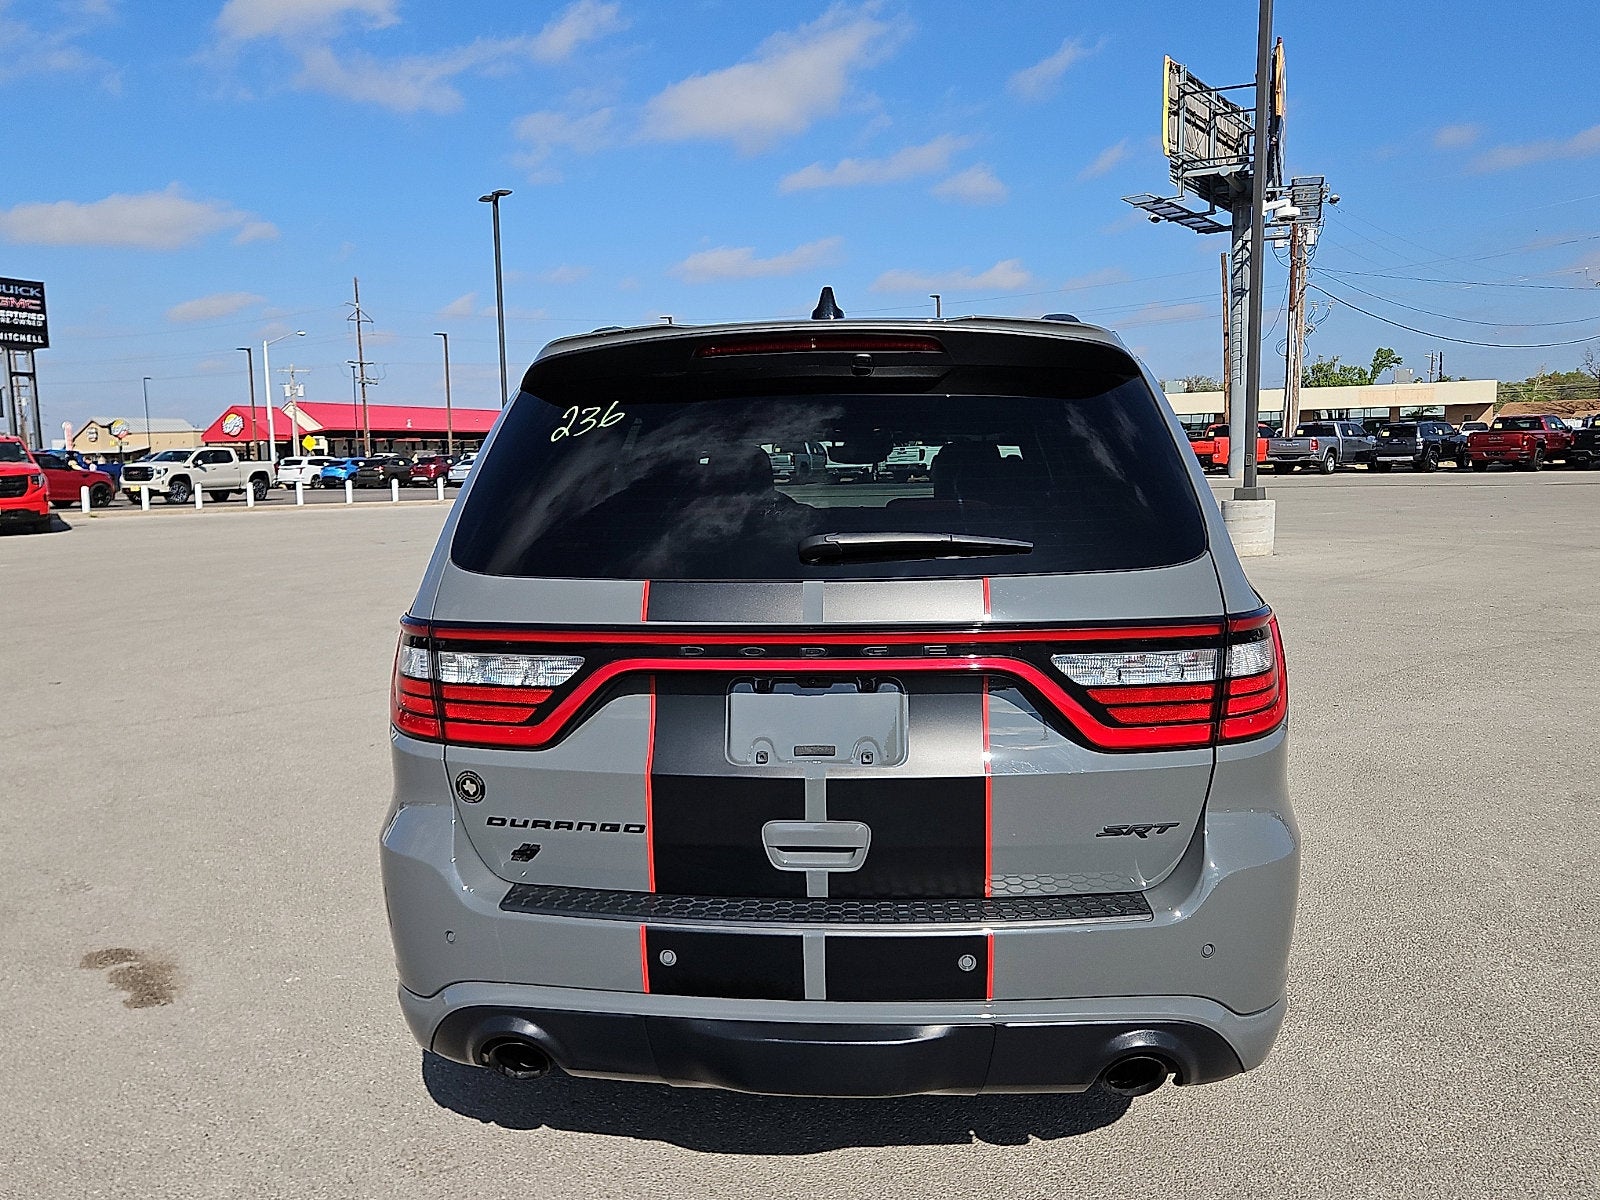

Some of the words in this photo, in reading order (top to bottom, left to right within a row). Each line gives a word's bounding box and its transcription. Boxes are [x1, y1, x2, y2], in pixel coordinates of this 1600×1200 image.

[550, 400, 626, 443] 236
[680, 645, 949, 657] DODGE
[486, 816, 646, 834] DURANGO
[1096, 822, 1180, 839] SRT
